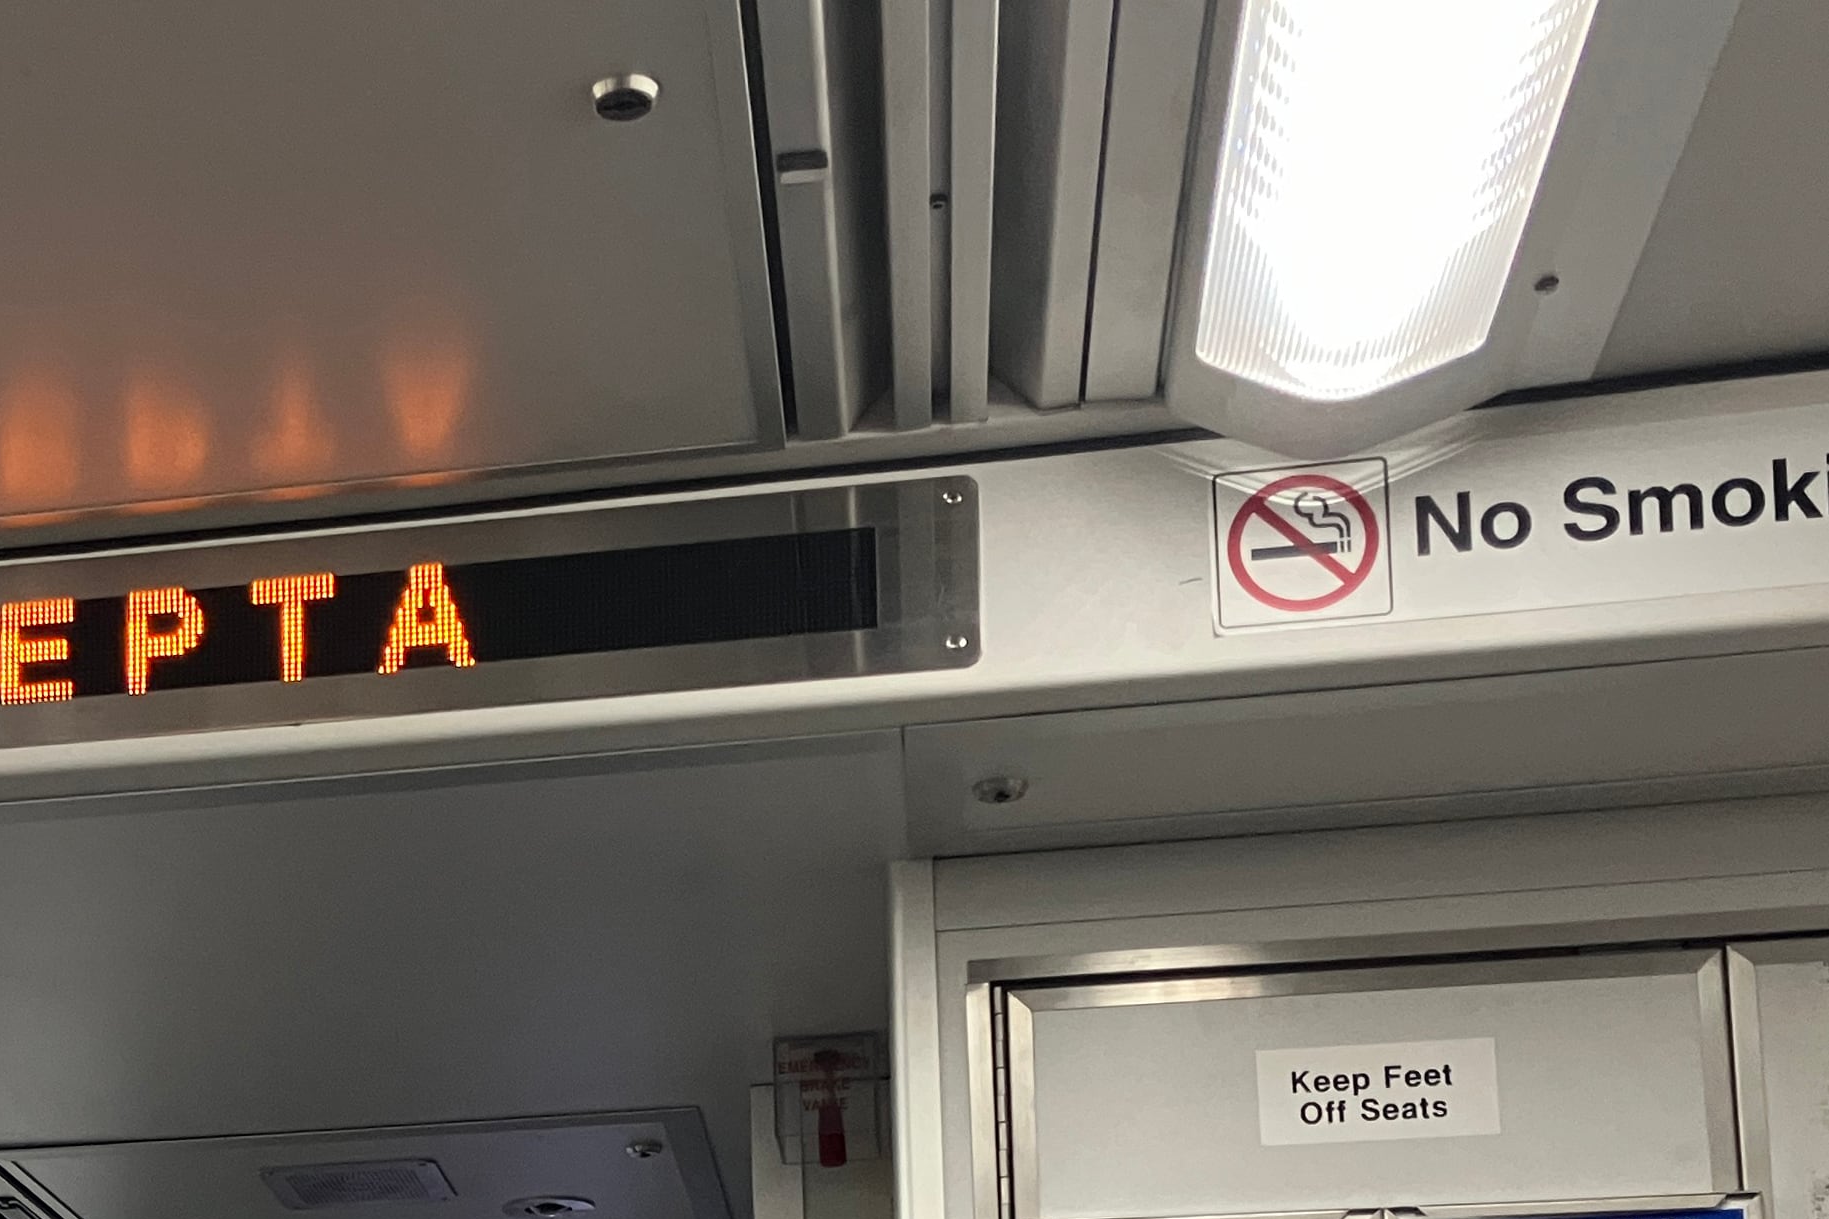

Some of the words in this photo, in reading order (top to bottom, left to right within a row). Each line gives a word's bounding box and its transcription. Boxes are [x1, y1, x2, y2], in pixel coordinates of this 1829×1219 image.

[1415, 490, 1533, 557] No
[1563, 453, 1829, 543] Smok
[1291, 1070, 1370, 1095] Keep
[1384, 1065, 1452, 1088] Feet
[1300, 1100, 1346, 1125] Off
[1361, 1097, 1447, 1121] Seats
